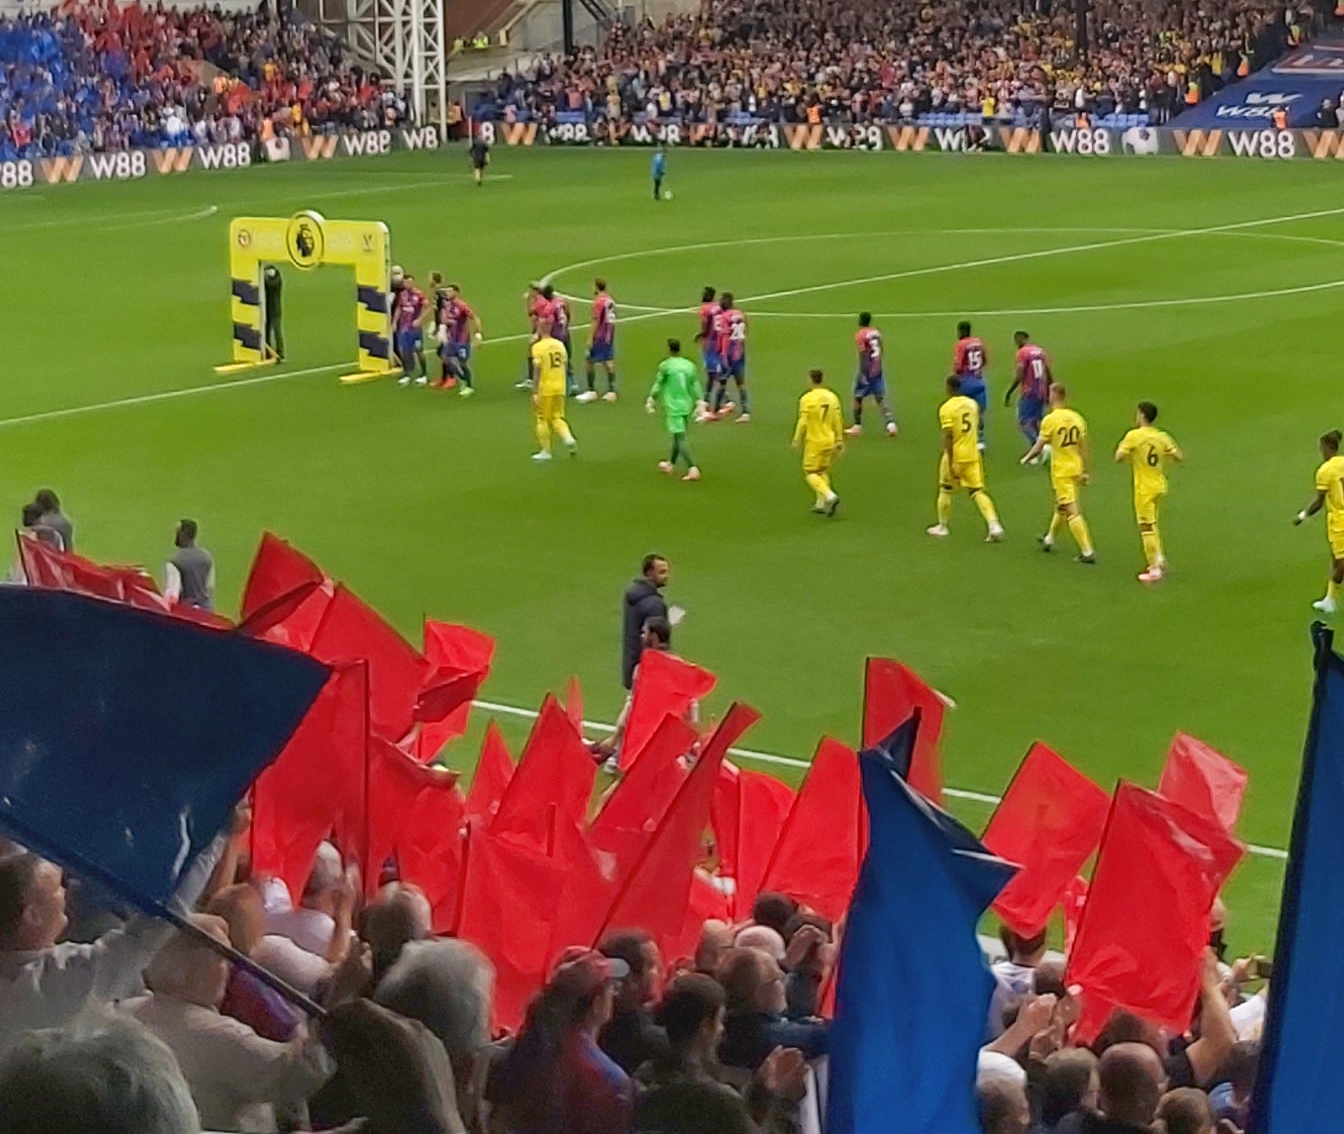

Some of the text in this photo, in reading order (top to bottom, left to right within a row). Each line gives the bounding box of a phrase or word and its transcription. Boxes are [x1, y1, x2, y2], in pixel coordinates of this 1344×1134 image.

[1051, 127, 1110, 155] W88
[1228, 130, 1296, 159] W88
[89, 149, 147, 180] W88
[198, 140, 252, 171] W88
[967, 350, 983, 370] 15
[820, 404, 830, 423] 7
[961, 413, 972, 434] 5
[1057, 425, 1080, 448] 20
[1147, 445, 1159, 468] 6
